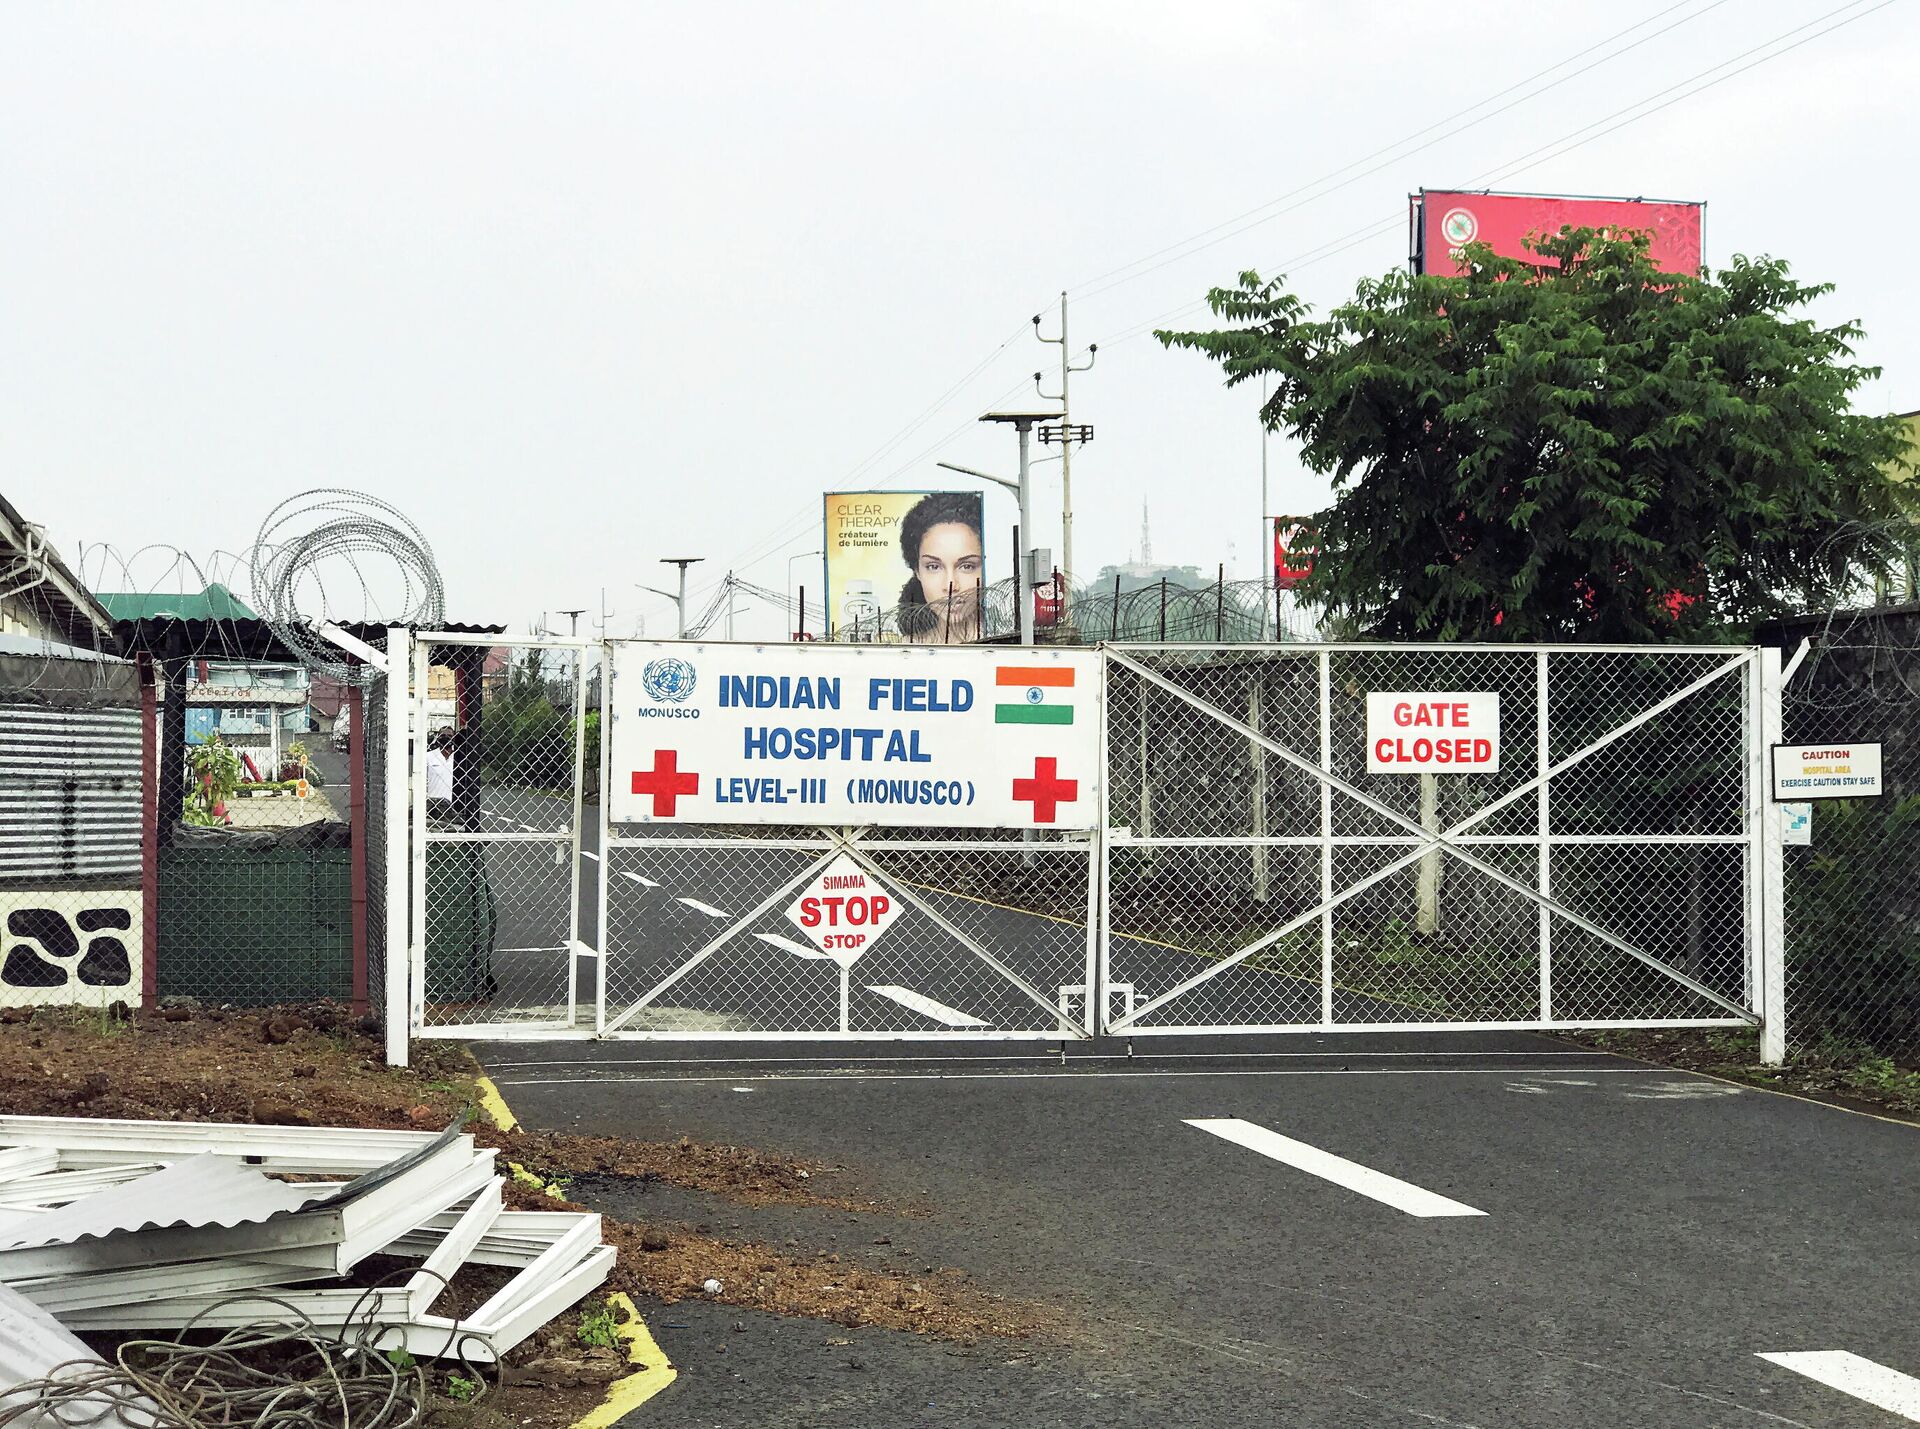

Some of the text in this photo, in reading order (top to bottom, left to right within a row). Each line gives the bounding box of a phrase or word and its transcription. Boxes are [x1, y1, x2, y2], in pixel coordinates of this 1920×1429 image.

[837, 504, 882, 516] CLEAR
[837, 516, 900, 528] THERAPY
[838, 530, 878, 539] créateur
[838, 539, 889, 547] de lumière
[719, 675, 974, 713] INDIAN FIELD
[638, 707, 701, 719] MONUSCO
[1393, 702, 1469, 727] GATE
[744, 727, 932, 763] HOSPITAL
[1375, 738, 1492, 763] CLOSED
[1802, 750, 1850, 760] CAUTION
[1802, 766, 1833, 776] HOSPITAL
[1781, 776, 1876, 787] EXERCISE CAUTION STAY SAFE
[715, 777, 976, 806] LEVEL-III (MONUSCO)
[823, 875, 866, 889] SIMAMA
[800, 896, 889, 927] STOP
[823, 934, 866, 949] STOP
